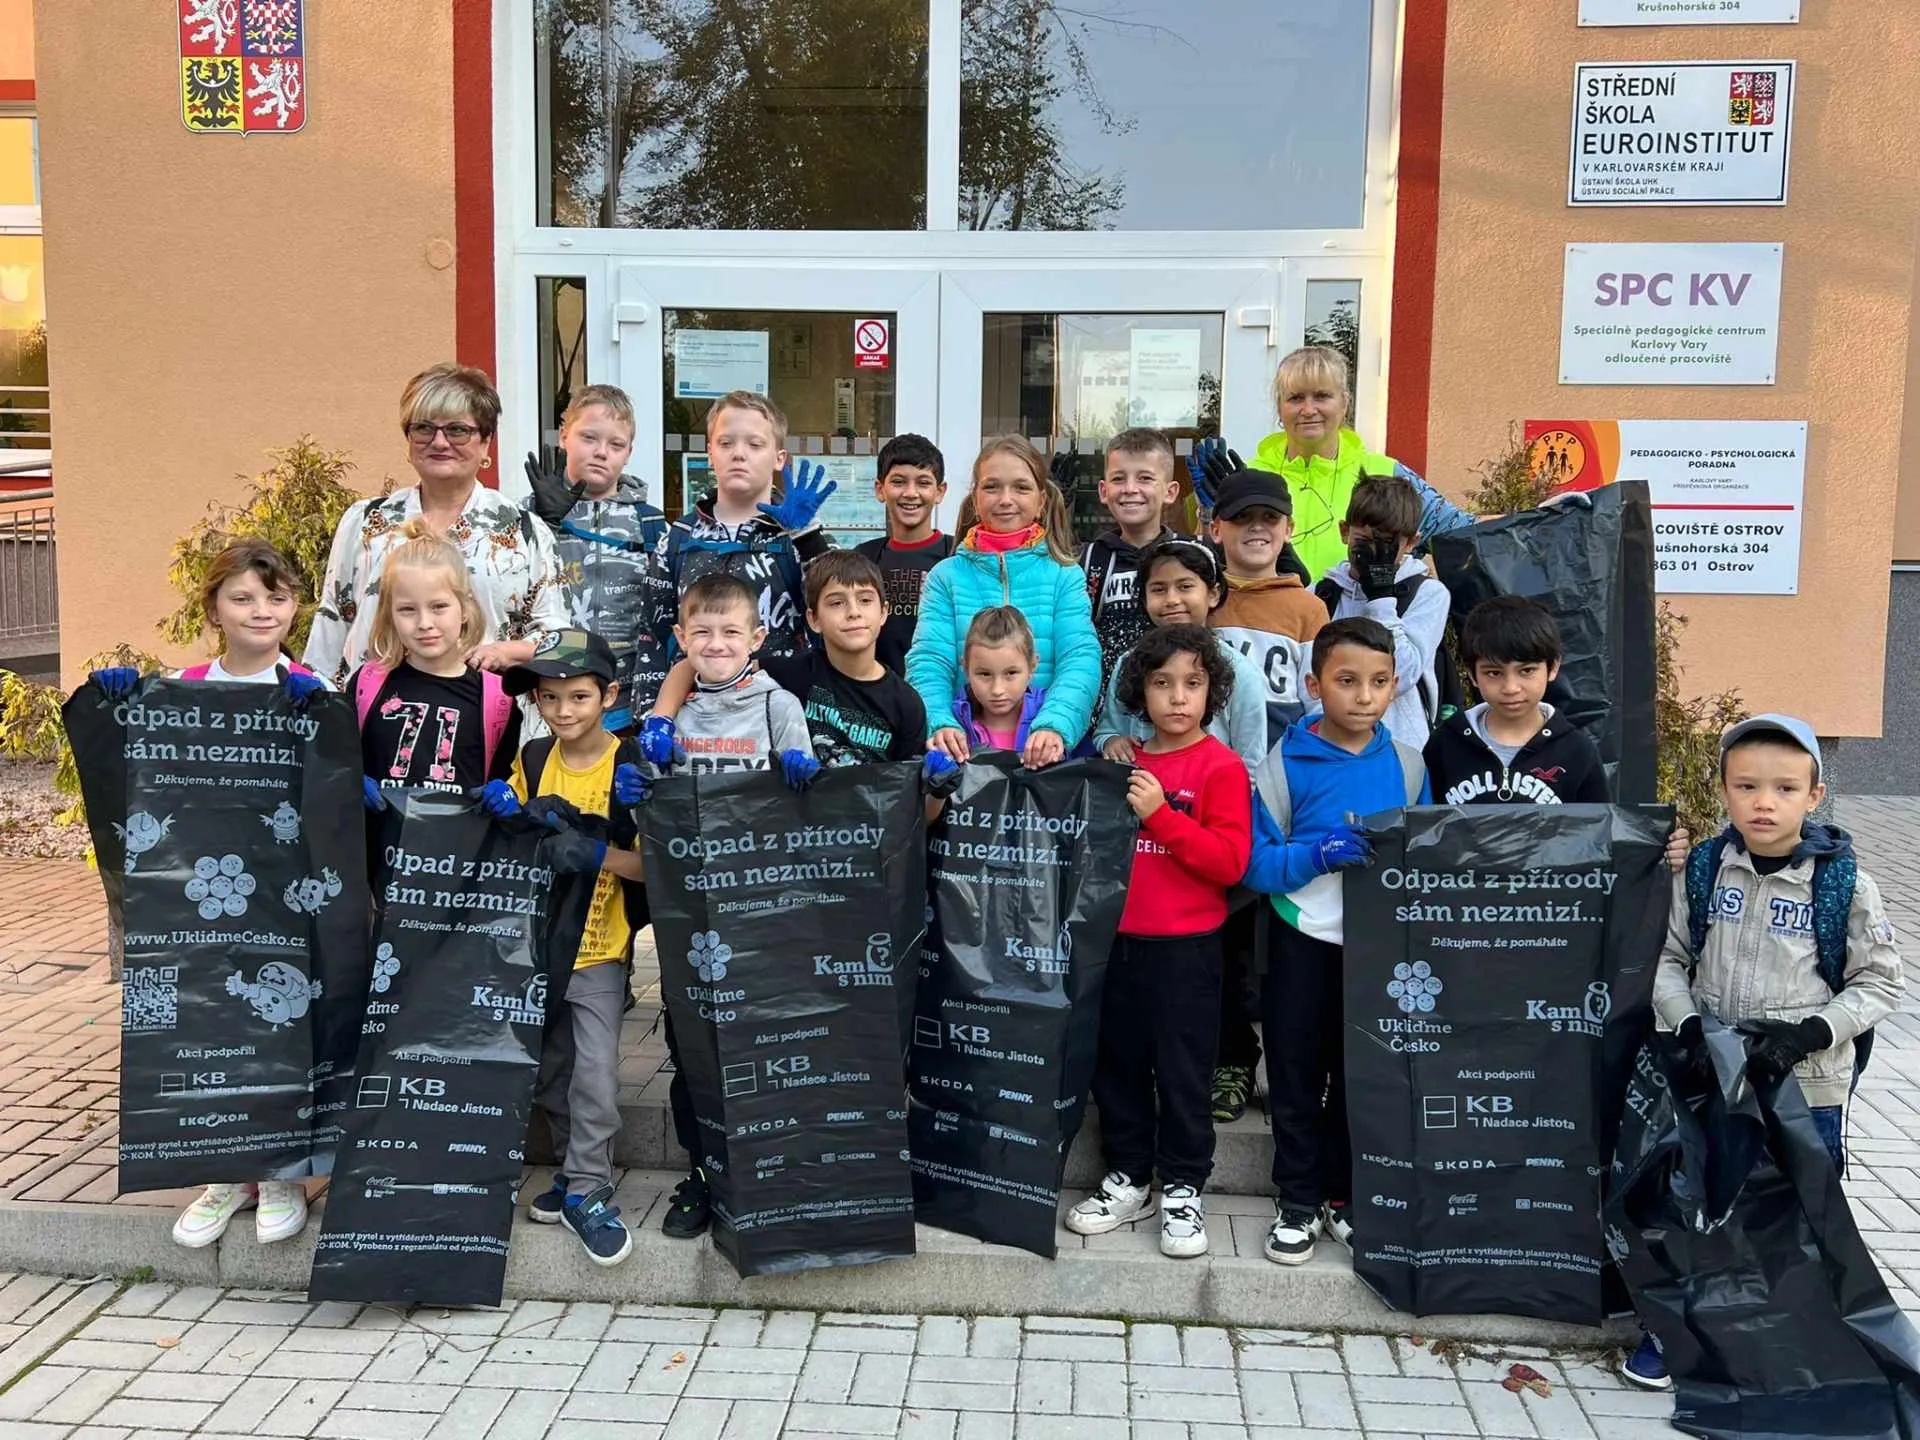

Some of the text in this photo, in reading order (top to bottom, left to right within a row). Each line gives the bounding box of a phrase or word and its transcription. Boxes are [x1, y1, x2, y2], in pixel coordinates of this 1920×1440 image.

[1637, 0, 1741, 13] Krušnohorská 304
[1587, 72, 1677, 97] STŘEDNÍ
[1585, 101, 1655, 124] ŠKOLA
[1583, 132, 1774, 155] EUROINSTITUT
[1582, 163, 1590, 172] V
[1593, 161, 1686, 173] KARLOVARSKÉM
[1594, 273, 1752, 306] SPC KV
[1717, 326, 1766, 335] centrum
[1631, 339, 1708, 352] Karlovy Vary
[1630, 450, 1702, 459] PEDAGOGICKO
[1688, 461, 1736, 469] PORADNA
[1655, 522, 1784, 537] COVIŠTĚ OSTROV
[1654, 541, 1769, 554] ušnohorská 304
[1681, 560, 1698, 572] 01
[1707, 560, 1755, 572] Ostrov
[210, 711, 226, 728] z
[232, 707, 321, 741] přírody
[848, 723, 892, 751] GAMER
[123, 740, 179, 761] sám
[154, 773, 289, 789] Děkujeme, že pomáháte
[979, 811, 993, 829] z
[998, 809, 1089, 840] přírody
[667, 822, 886, 864] Odpad z přírody
[460, 860, 475, 877] z
[478, 857, 555, 892] přírody
[684, 865, 738, 892] sám
[994, 874, 1046, 889] pomáháte
[1380, 866, 1619, 895] Odpad z přírody
[384, 880, 426, 906] ám
[717, 897, 775, 914] Děkujeme,
[777, 896, 790, 907] že
[1395, 900, 1454, 923] sám
[398, 918, 523, 939] Děkujeme, že pomáháte
[1004, 936, 1054, 961] Kam
[1430, 936, 1569, 949] Děkujeme, že pomáháte
[812, 954, 866, 976] Kam
[1026, 961, 1036, 973] s
[838, 975, 849, 987] s
[471, 985, 524, 1010] Kam
[493, 1009, 504, 1021] s
[1525, 999, 1582, 1020] Kam
[755, 1025, 830, 1046] Akci podpořili
[949, 1023, 991, 1044] KB
[1377, 1017, 1453, 1035] Ukliďme
[1551, 1020, 1562, 1033] s
[176, 1045, 256, 1060] Akci podpořili
[1389, 1034, 1441, 1053] Česko
[395, 1050, 421, 1062] Akci
[964, 1045, 1045, 1066] Nadace Jistota
[765, 1056, 812, 1078] KB
[1457, 1069, 1536, 1082] Akci podpořili
[192, 1071, 226, 1085] KB
[398, 1077, 447, 1097] KB
[782, 1070, 871, 1089] Nadace Jistota
[412, 1099, 503, 1117] Nadace Jistota
[1465, 1095, 1514, 1114] KB
[1482, 1116, 1576, 1131] Nadace Jistota
[449, 1184, 489, 1196] SCHENKER
[353, 1241, 394, 1253] Vyrobeno
